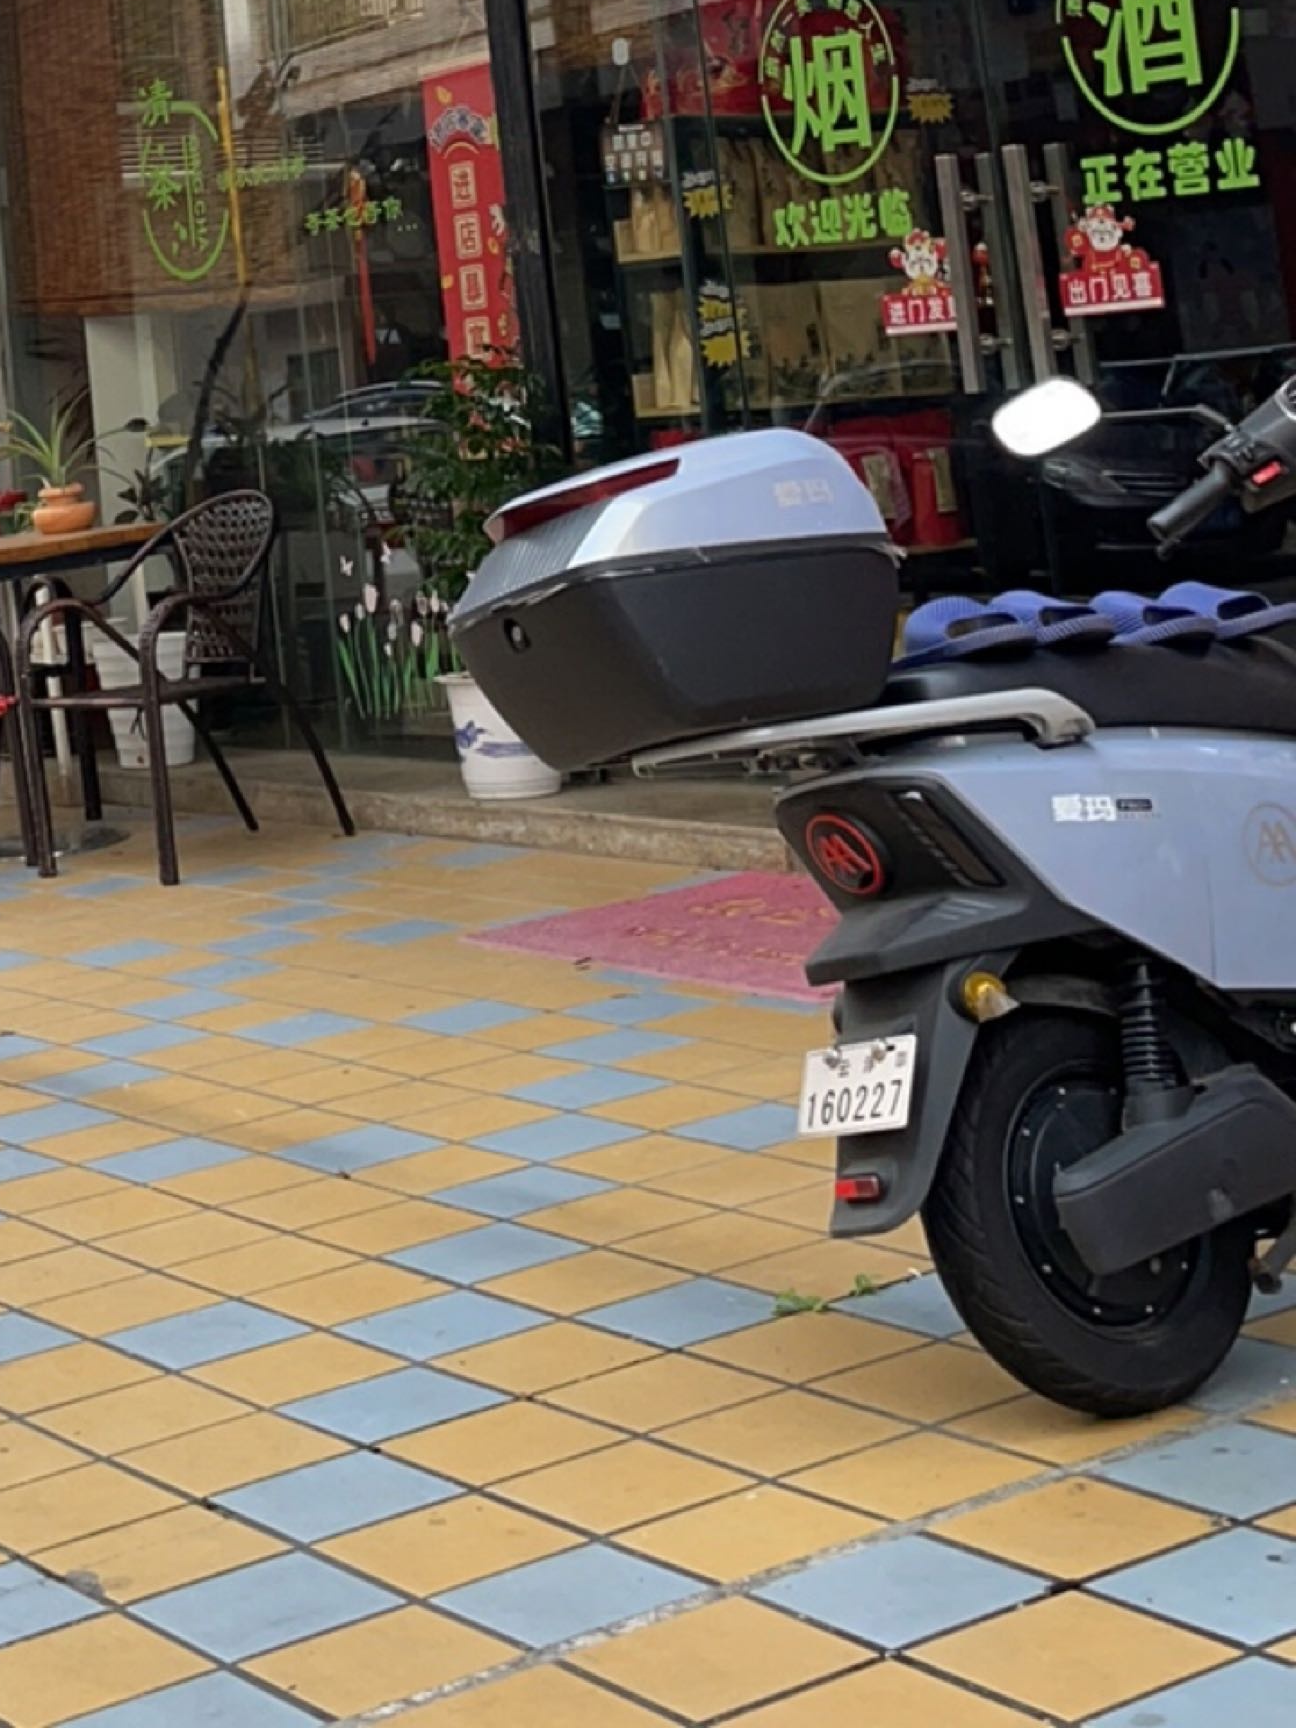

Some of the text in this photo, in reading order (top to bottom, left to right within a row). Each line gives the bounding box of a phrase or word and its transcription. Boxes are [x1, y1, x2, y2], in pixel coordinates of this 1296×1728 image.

[782, 28, 872, 156] 烟
[1079, 137, 1261, 206] 正在营业
[773, 187, 915, 249] 欢迎光临
[1067, 272, 1153, 304] 出门见喜
[807, 1078, 903, 1128] 160227
